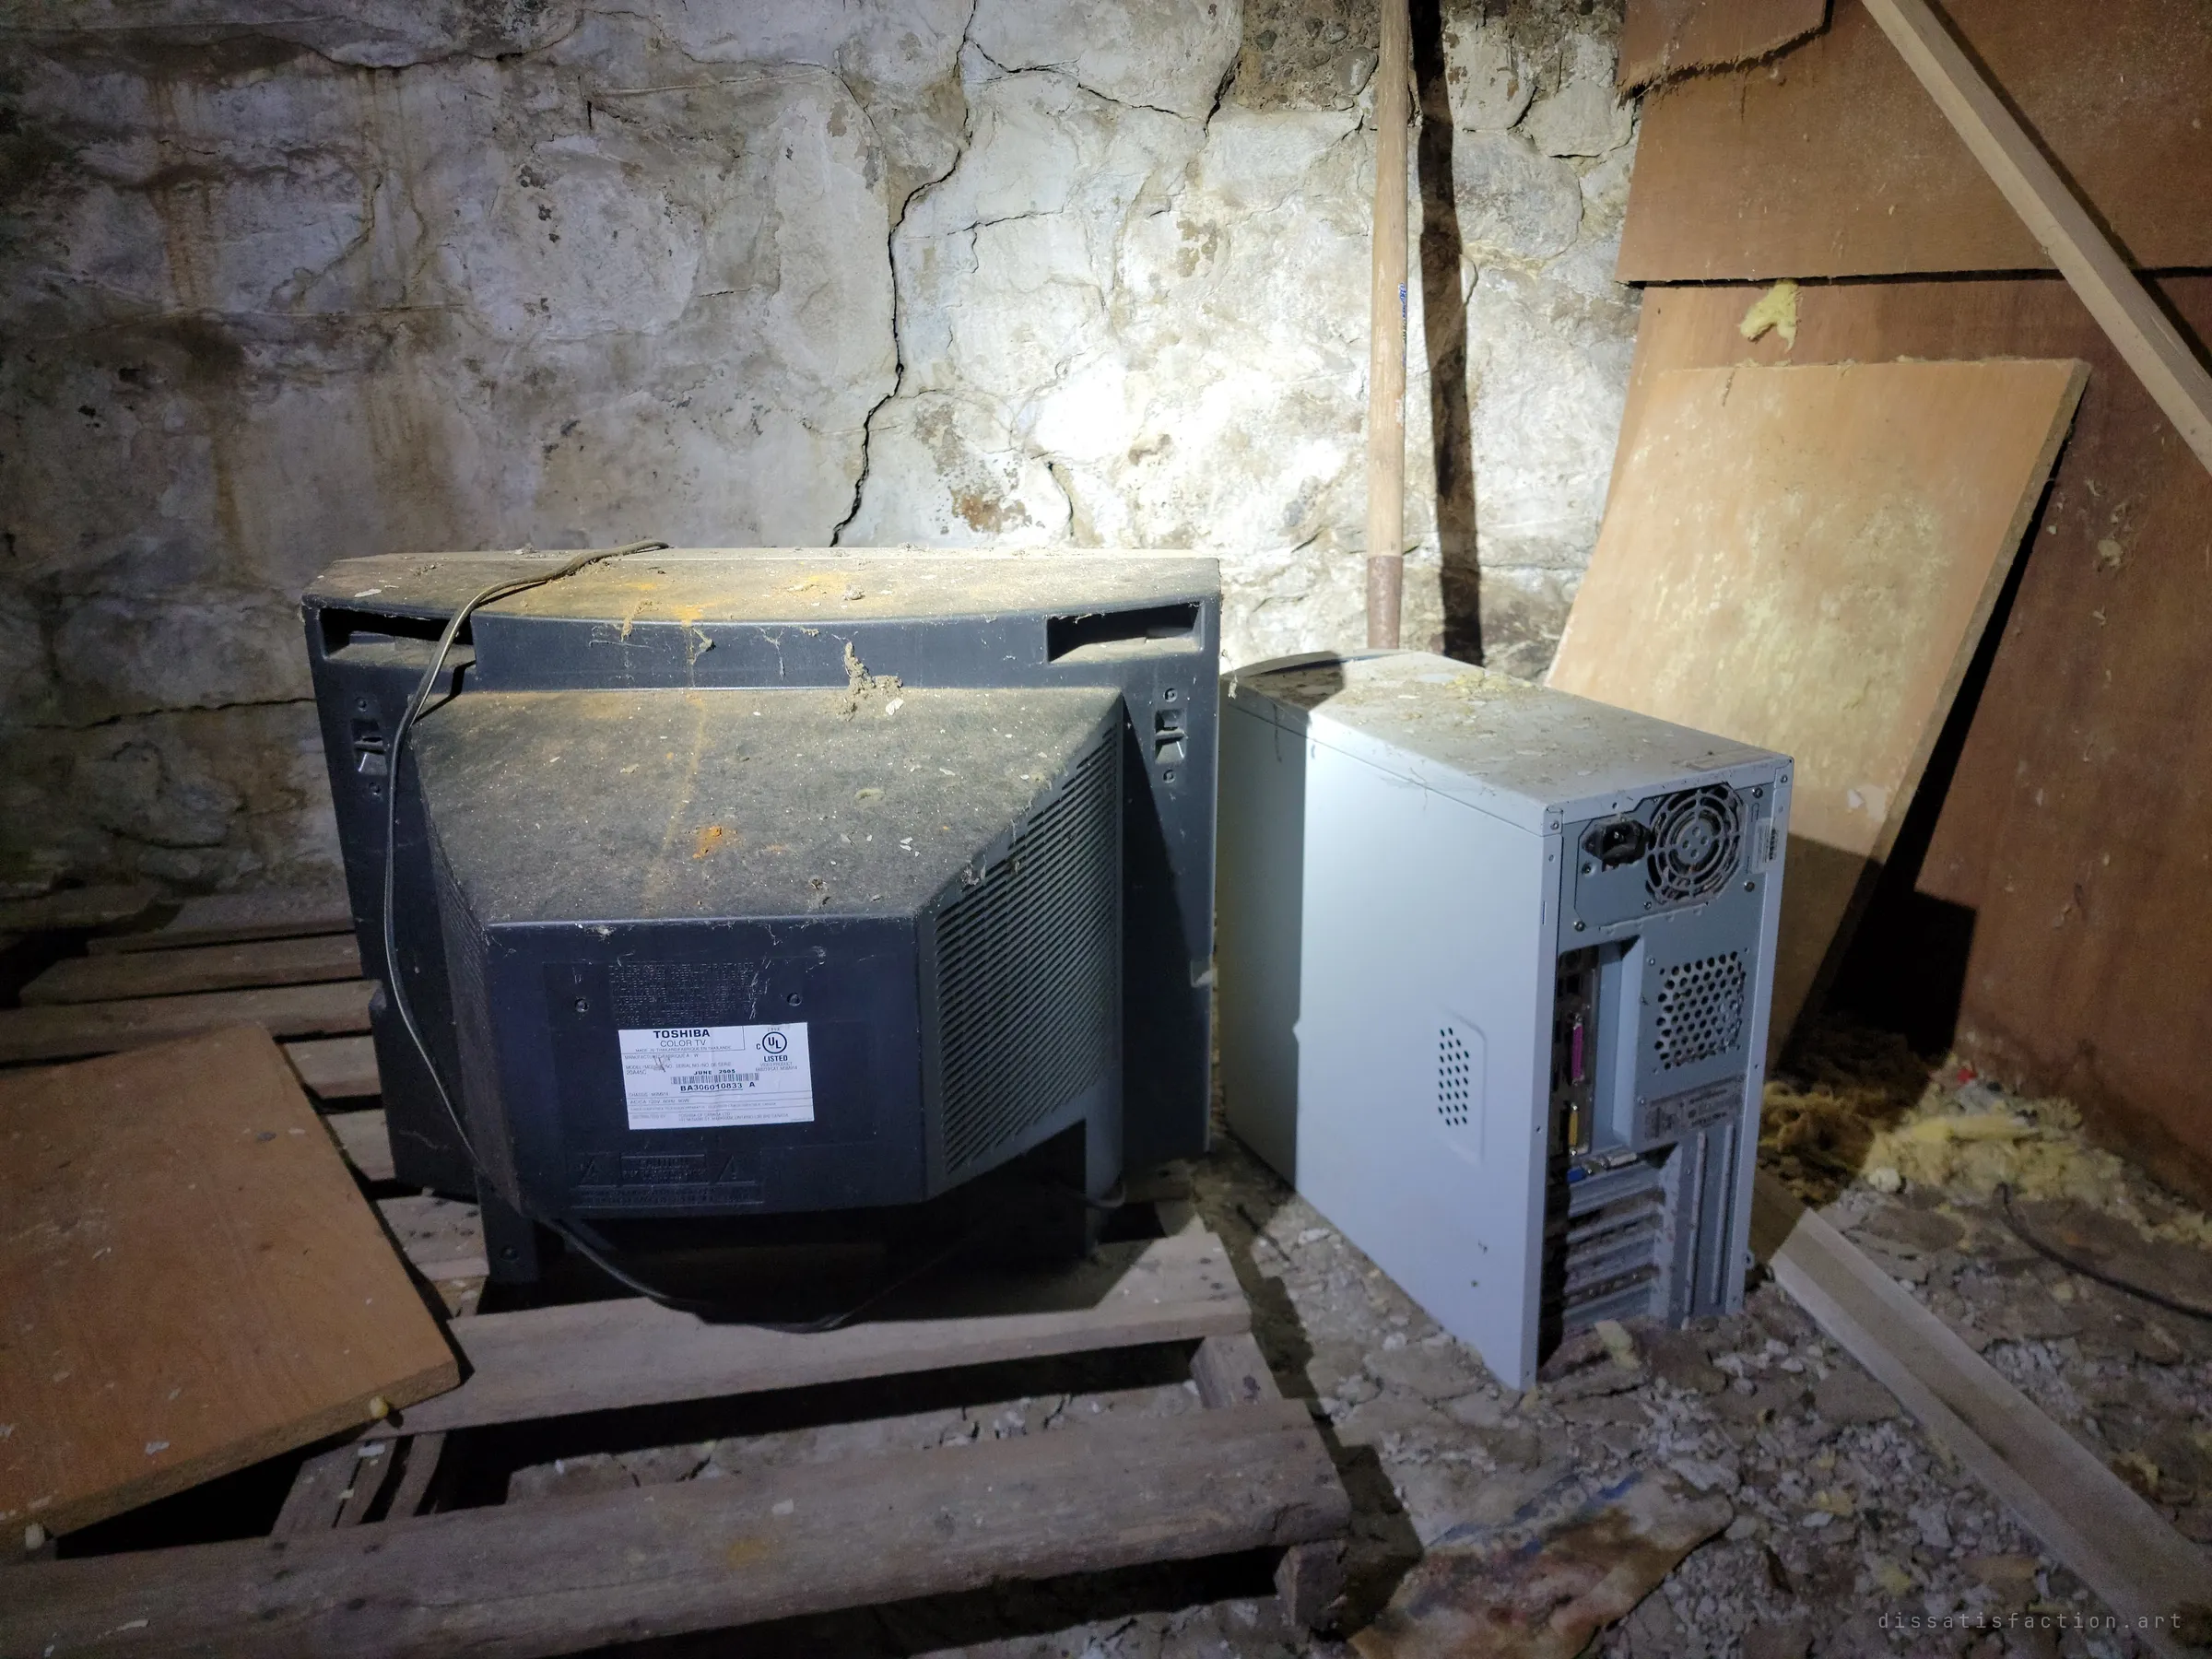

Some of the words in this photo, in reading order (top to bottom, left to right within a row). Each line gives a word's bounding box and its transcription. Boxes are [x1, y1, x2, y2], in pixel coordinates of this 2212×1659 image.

[653, 1029, 711, 1039] TOSHIBA
[768, 1036, 782, 1049] UL
[763, 1054, 788, 1063] LISTED
[680, 1082, 743, 1091] BA306010833
